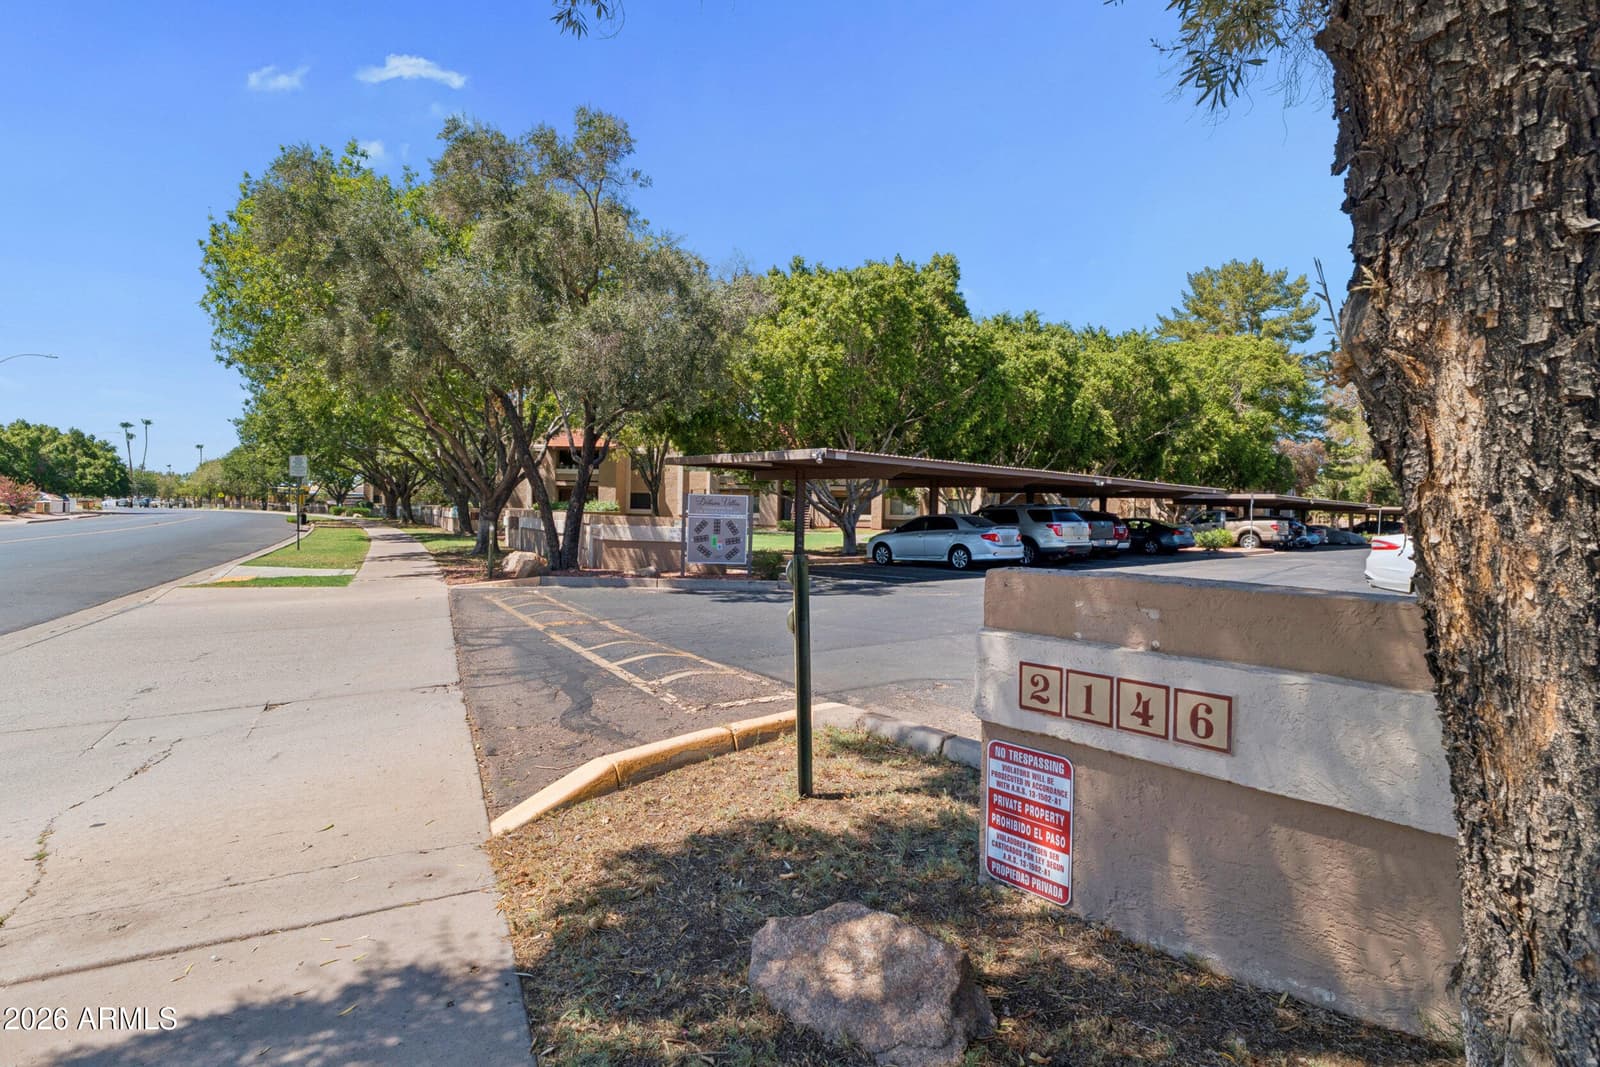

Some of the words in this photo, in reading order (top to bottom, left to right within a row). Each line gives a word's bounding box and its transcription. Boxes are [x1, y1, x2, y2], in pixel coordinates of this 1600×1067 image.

[1030, 674, 1214, 739] 2146
[994, 746, 1006, 758] NO
[1008, 750, 1064, 774] TRESPASSING
[992, 770, 1023, 785] PROSECUTED
[1025, 779, 1030, 787] IN
[1032, 782, 1068, 798] ACCORDANCE
[996, 780, 1010, 790] WITH
[1001, 764, 1030, 778] VIOLATORS
[1032, 772, 1045, 782] WILL
[1047, 777, 1054, 785] BE
[993, 793, 1022, 812] PRIVATE
[1025, 804, 1064, 826] PROPERTY
[992, 813, 1031, 836] PROHIBIDO
[1034, 827, 1043, 840] EL
[1046, 831, 1066, 848] PASO
[1024, 851, 1034, 860] POR
[1036, 856, 1045, 865] LEY
[1028, 844, 1047, 858] PUEDEN
[1049, 852, 1060, 862] SER
[992, 862, 1030, 885] PROPIEDAD
[1032, 878, 1063, 899] PRIVADA
